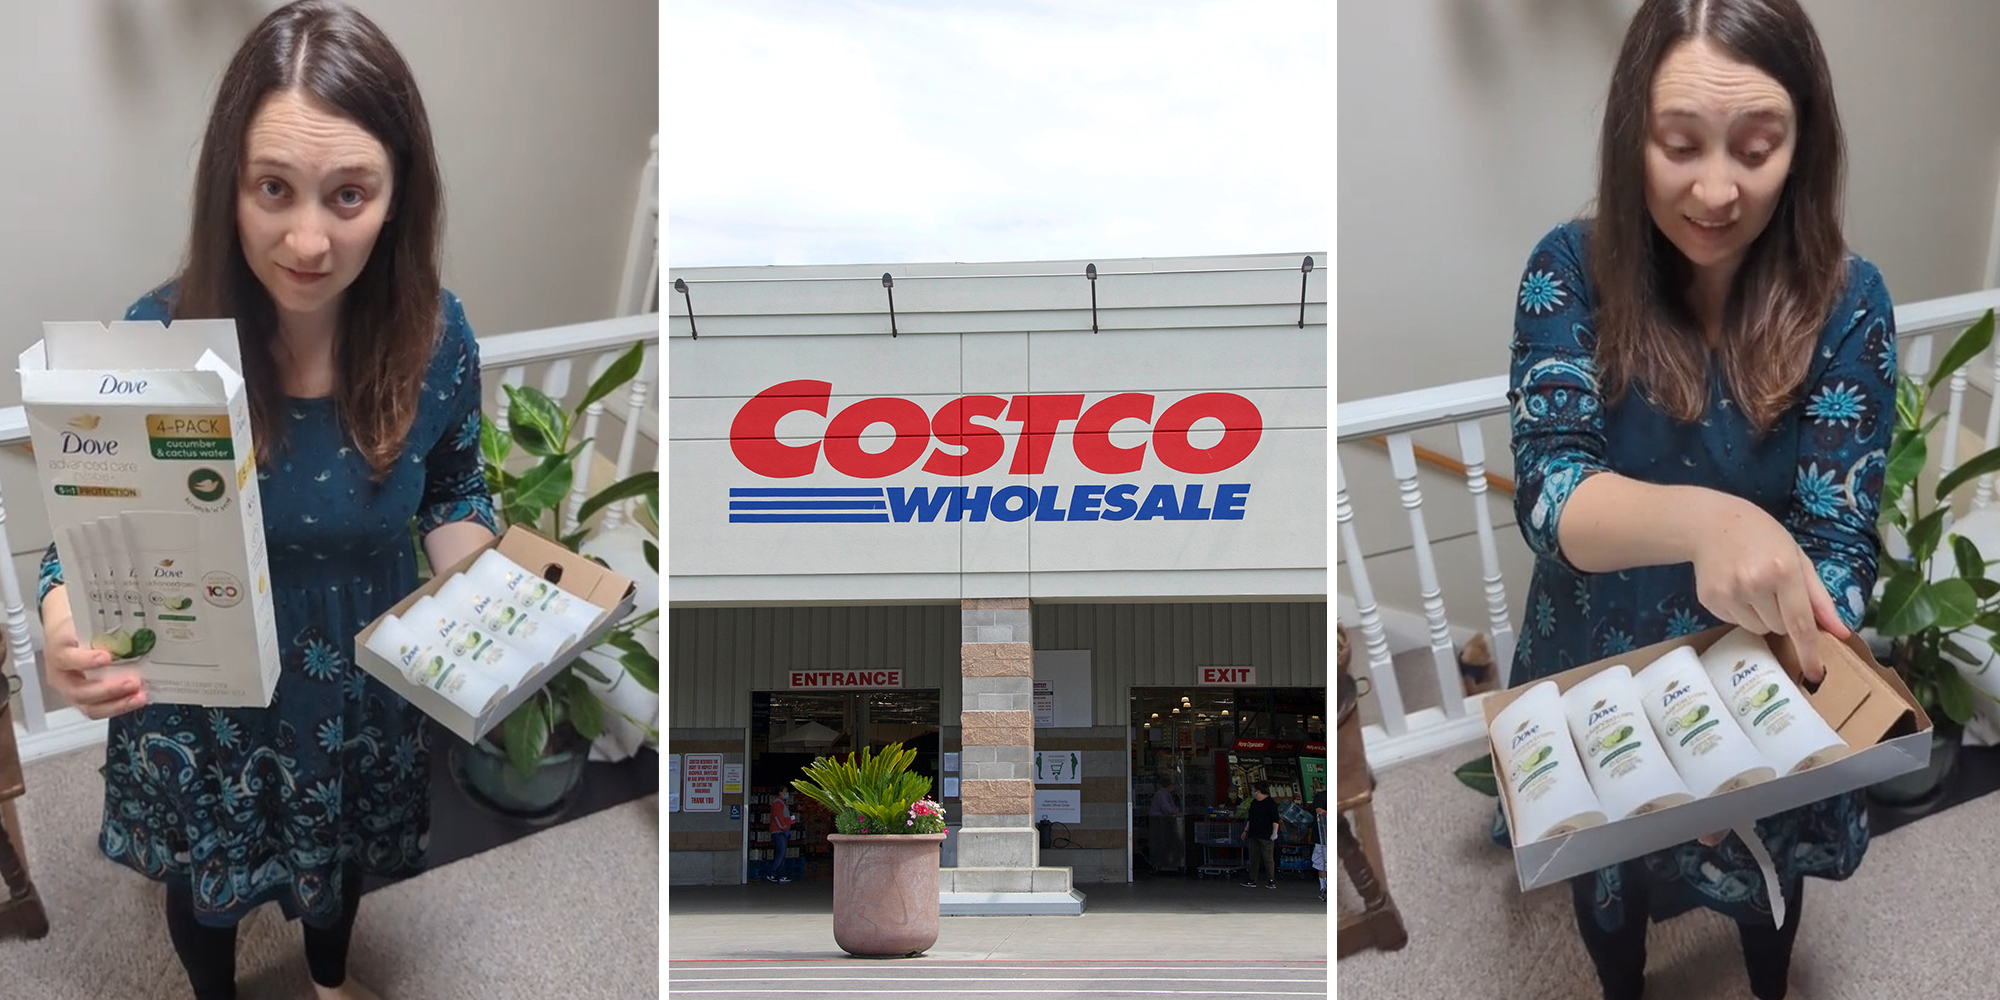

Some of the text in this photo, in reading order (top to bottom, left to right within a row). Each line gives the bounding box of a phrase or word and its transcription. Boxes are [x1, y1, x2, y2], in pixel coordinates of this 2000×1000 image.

[99, 374, 147, 394] Dove
[156, 419, 220, 434] 4-PACK
[730, 380, 1263, 478] COSTCO
[60, 431, 118, 455] Dove
[166, 440, 216, 448] cucumber
[157, 448, 228, 458] & cactus water
[49, 459, 138, 472] advanced care
[79, 486, 137, 497] PROTECTION
[884, 483, 1252, 523] WHOLESALE
[154, 567, 183, 578] Dove
[507, 573, 523, 590] Dove
[474, 597, 491, 614] Dove
[439, 621, 457, 638] Dove
[401, 645, 419, 666] Dove
[792, 671, 899, 686] ENTRANCE
[1204, 669, 1250, 682] EXIT
[1732, 664, 1758, 686] Dove
[1663, 685, 1690, 707] Dove
[1589, 705, 1617, 726] Dove
[1512, 725, 1539, 749] Dove
